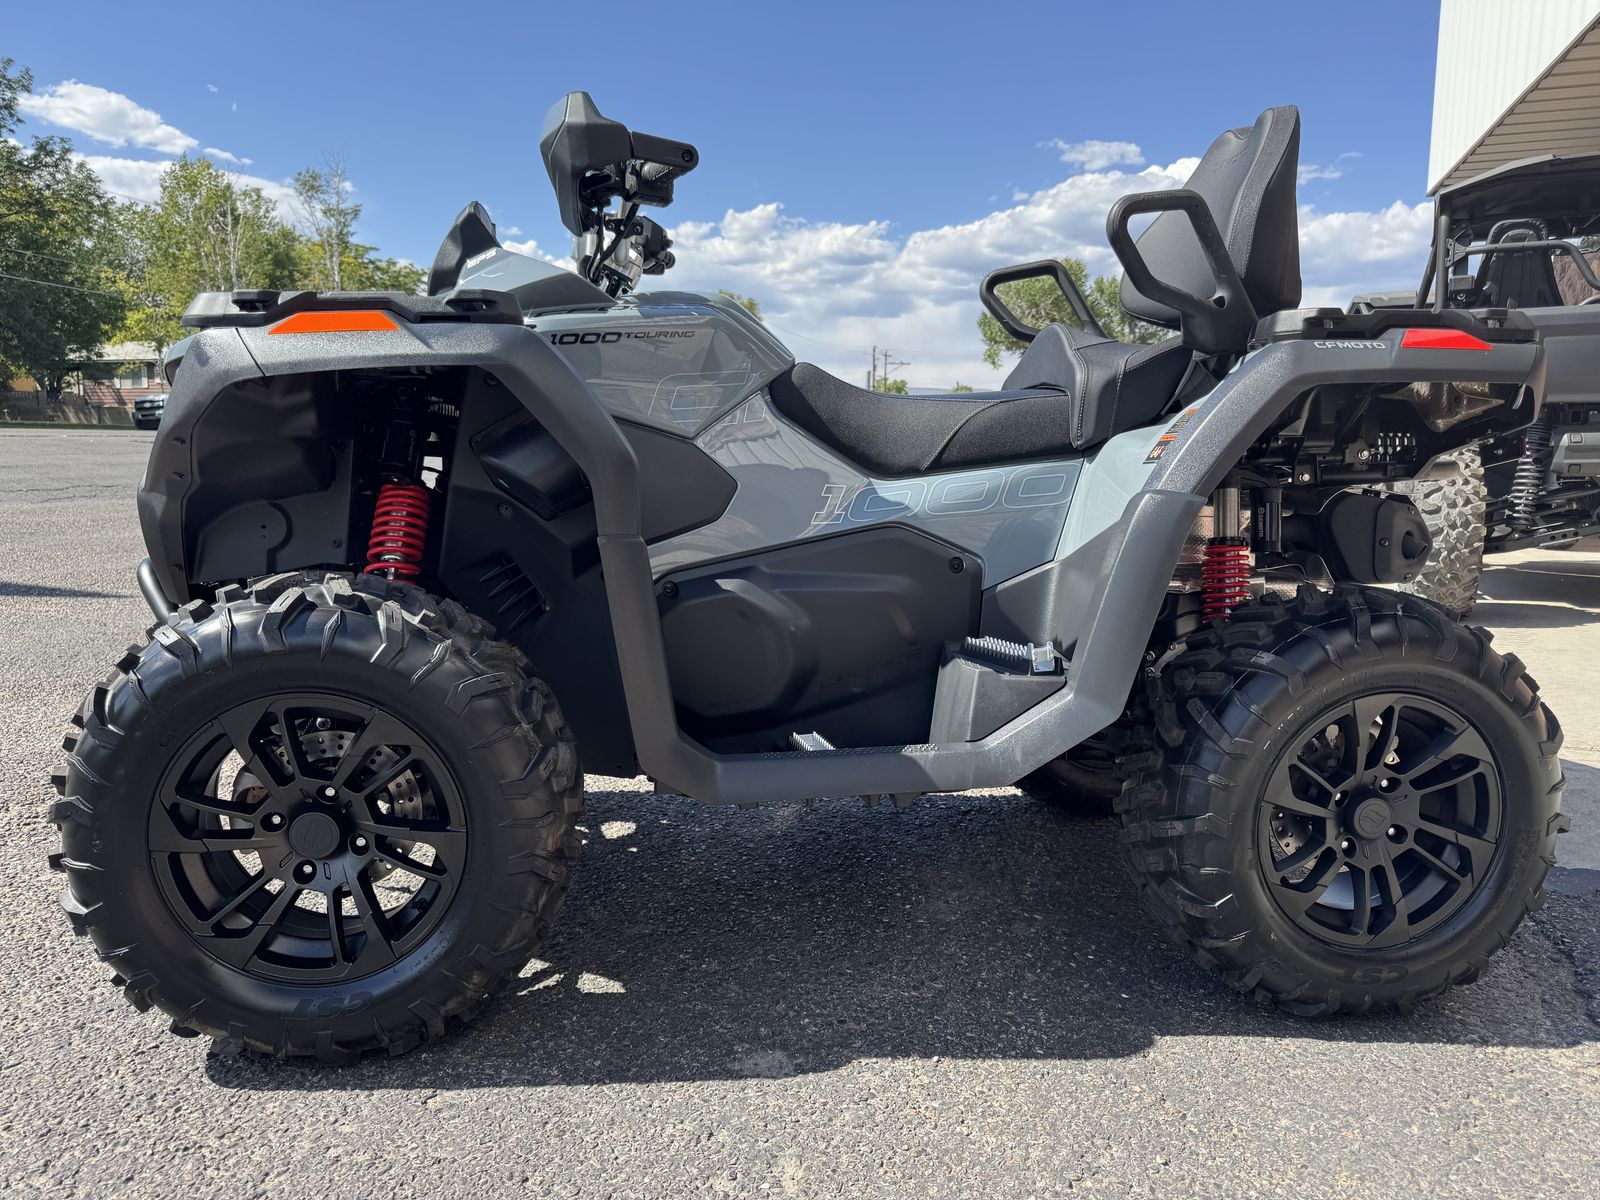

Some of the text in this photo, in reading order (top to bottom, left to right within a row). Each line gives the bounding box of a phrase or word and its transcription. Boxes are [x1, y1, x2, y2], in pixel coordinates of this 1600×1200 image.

[466, 249, 497, 269] EPS
[550, 330, 696, 346] 1000 TOURING
[1313, 341, 1386, 349] CFMOTO
[811, 463, 1081, 524] 1000
[280, 991, 375, 1020] CST
